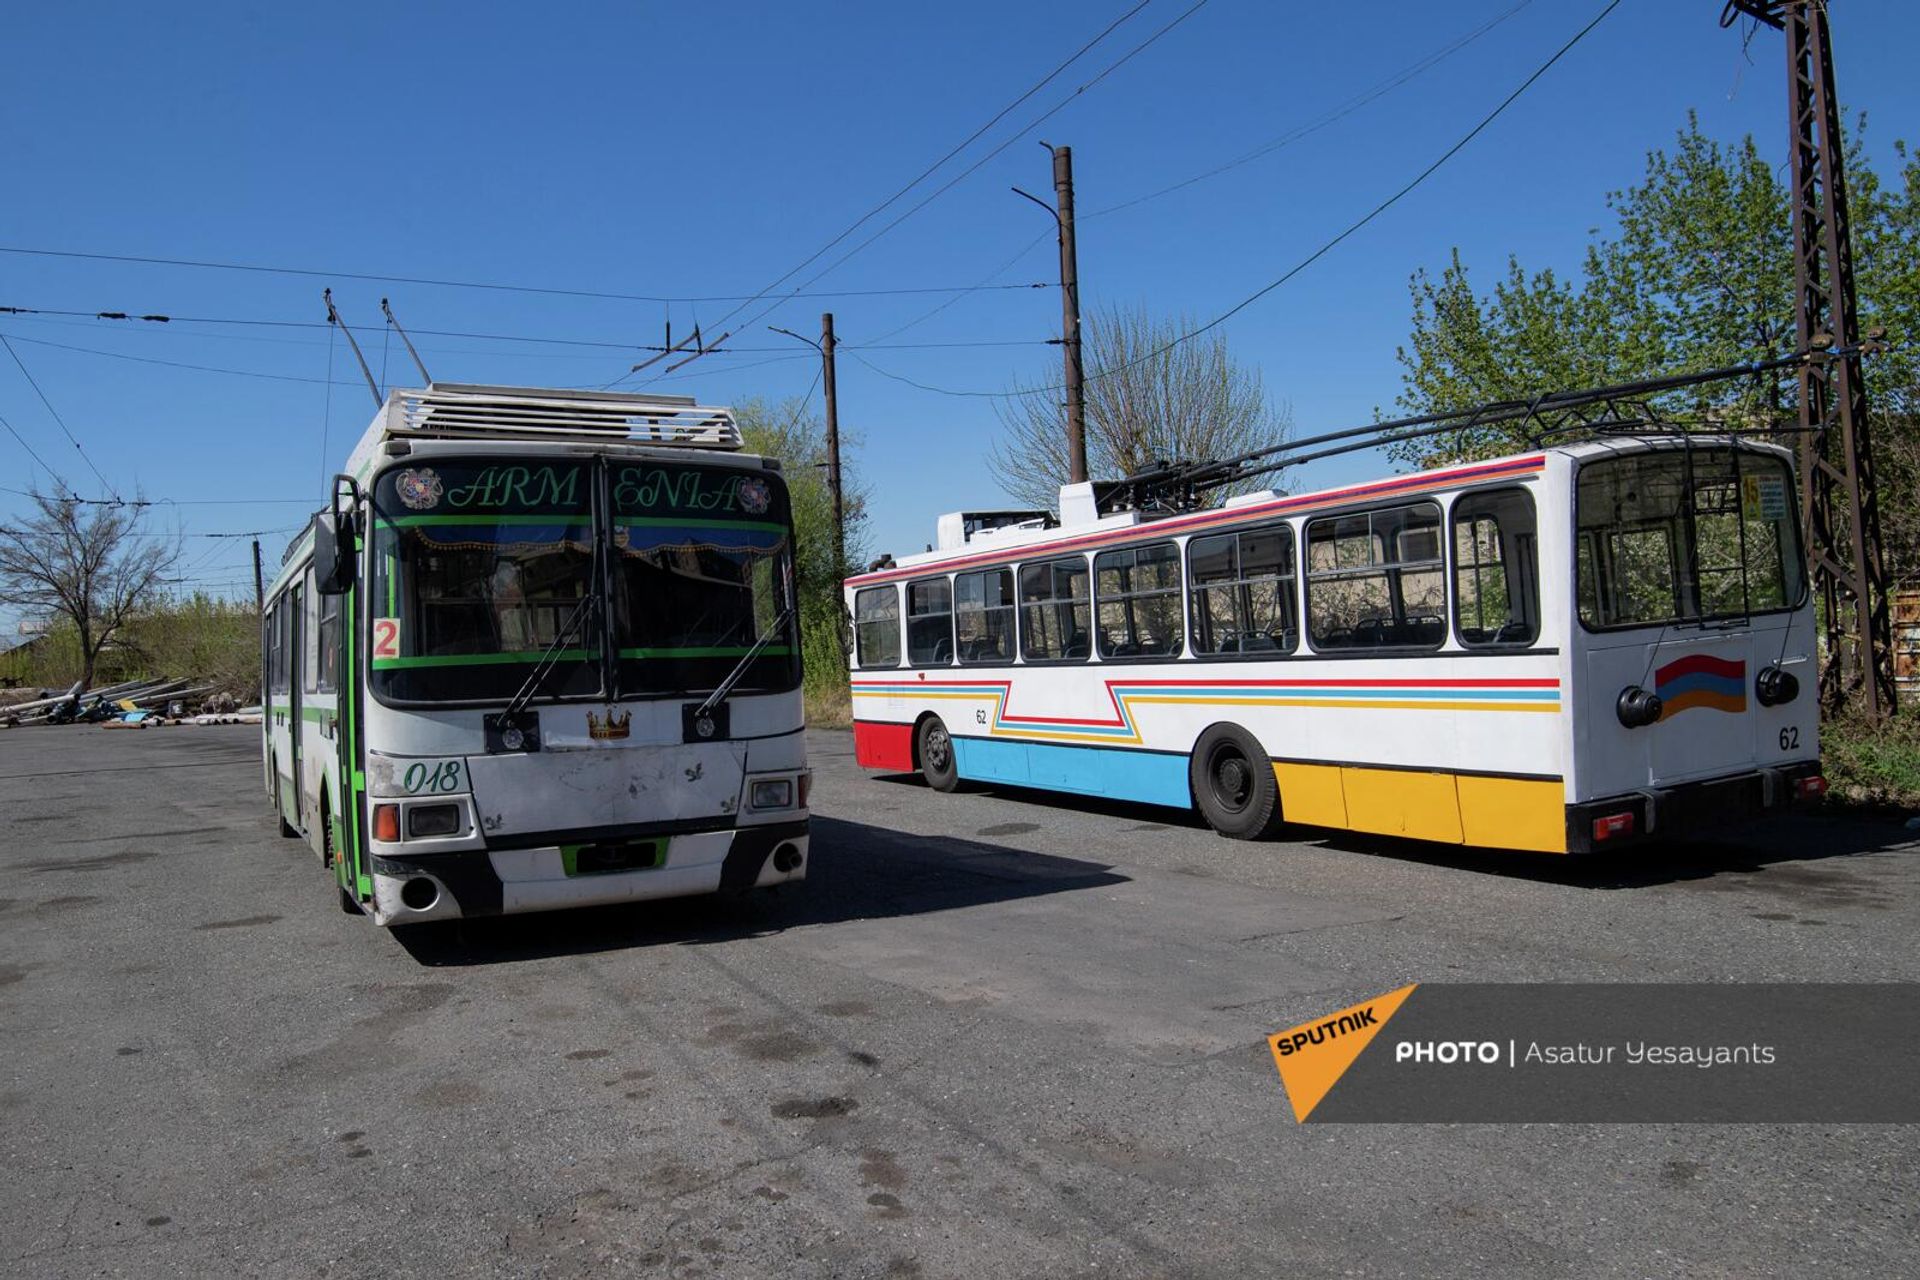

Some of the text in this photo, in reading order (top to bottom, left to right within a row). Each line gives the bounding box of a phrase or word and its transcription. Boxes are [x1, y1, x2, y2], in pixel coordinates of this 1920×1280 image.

[447, 466, 580, 507] ARM
[374, 620, 397, 656] 2
[976, 709, 986, 724] 62
[1779, 726, 1799, 750] 62
[404, 760, 460, 794] 018
